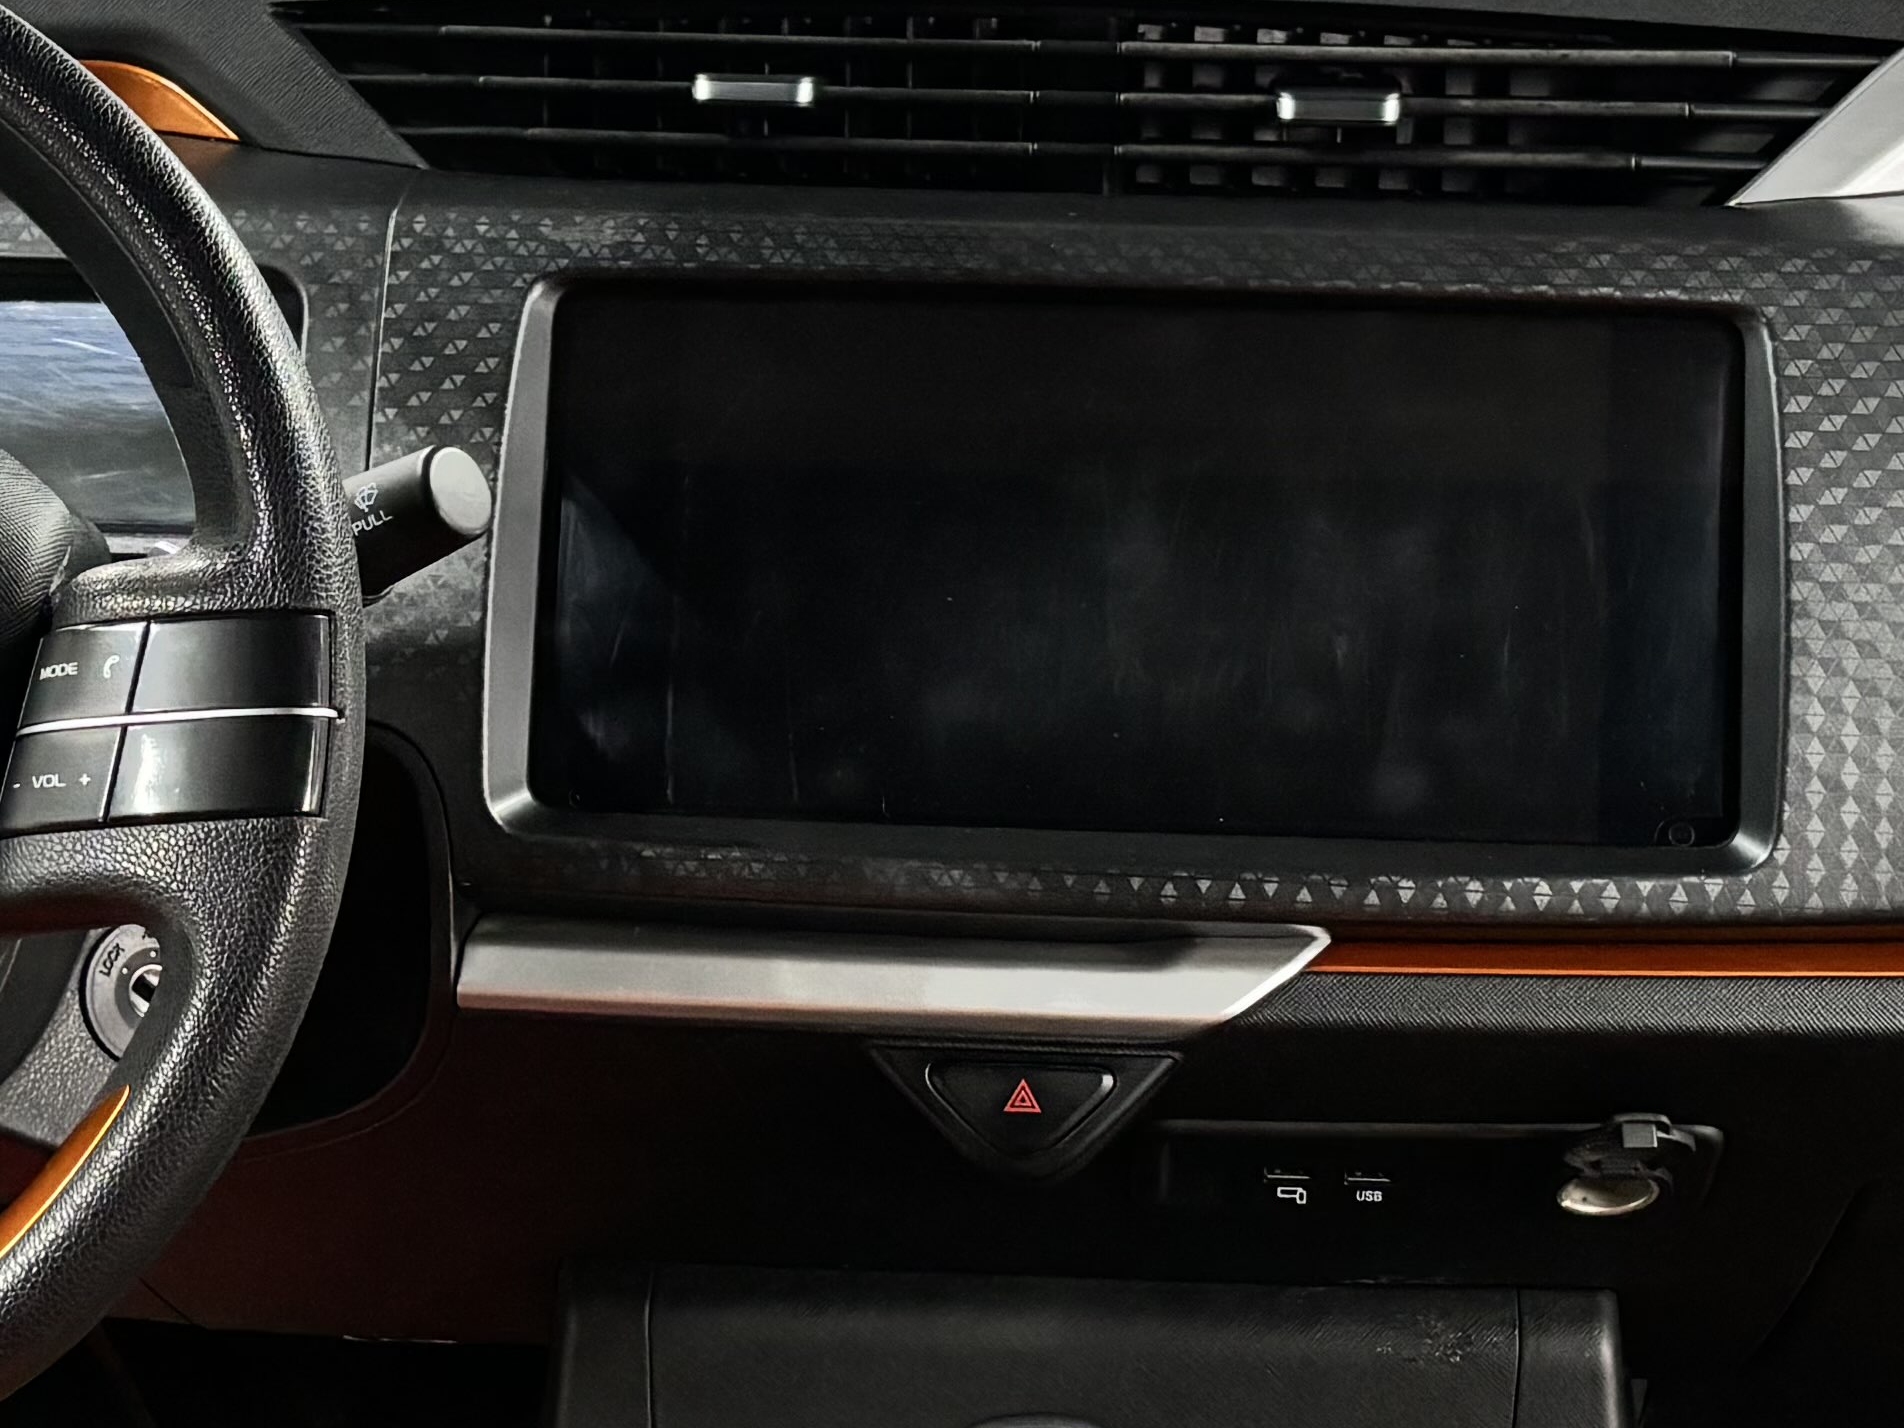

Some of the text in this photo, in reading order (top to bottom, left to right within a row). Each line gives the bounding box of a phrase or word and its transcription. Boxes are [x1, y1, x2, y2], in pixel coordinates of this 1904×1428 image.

[351, 509, 394, 536] PULL
[39, 661, 79, 681] MODE
[31, 773, 67, 789] VOL
[1355, 1190, 1383, 1202] USB
